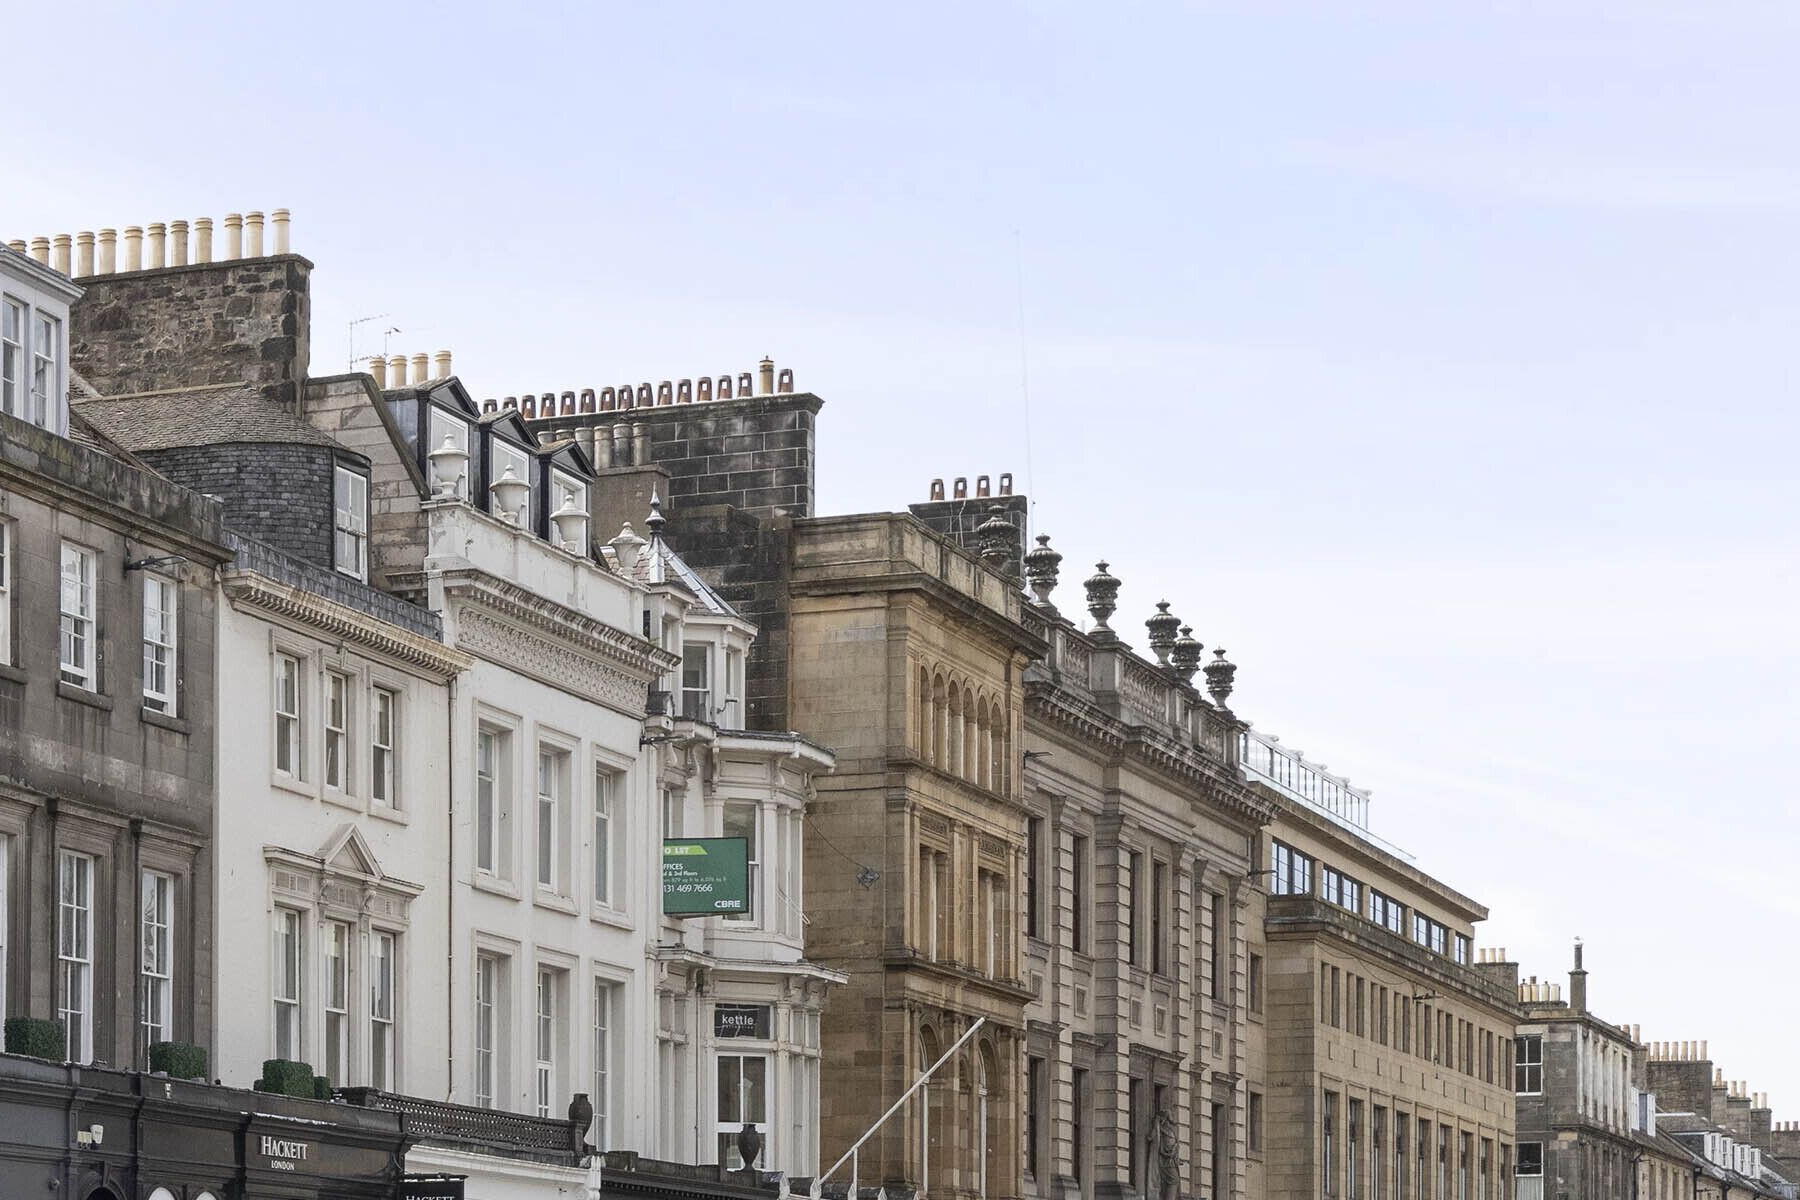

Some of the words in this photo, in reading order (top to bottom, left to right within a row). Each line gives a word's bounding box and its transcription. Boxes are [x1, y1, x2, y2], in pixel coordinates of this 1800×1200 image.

[677, 884, 692, 892] 469
[693, 884, 712, 892] 7666
[714, 900, 741, 908] CBRE
[722, 1014, 754, 1025] kettle
[261, 1136, 308, 1159] HACKETT
[271, 1160, 295, 1170] LONDON
